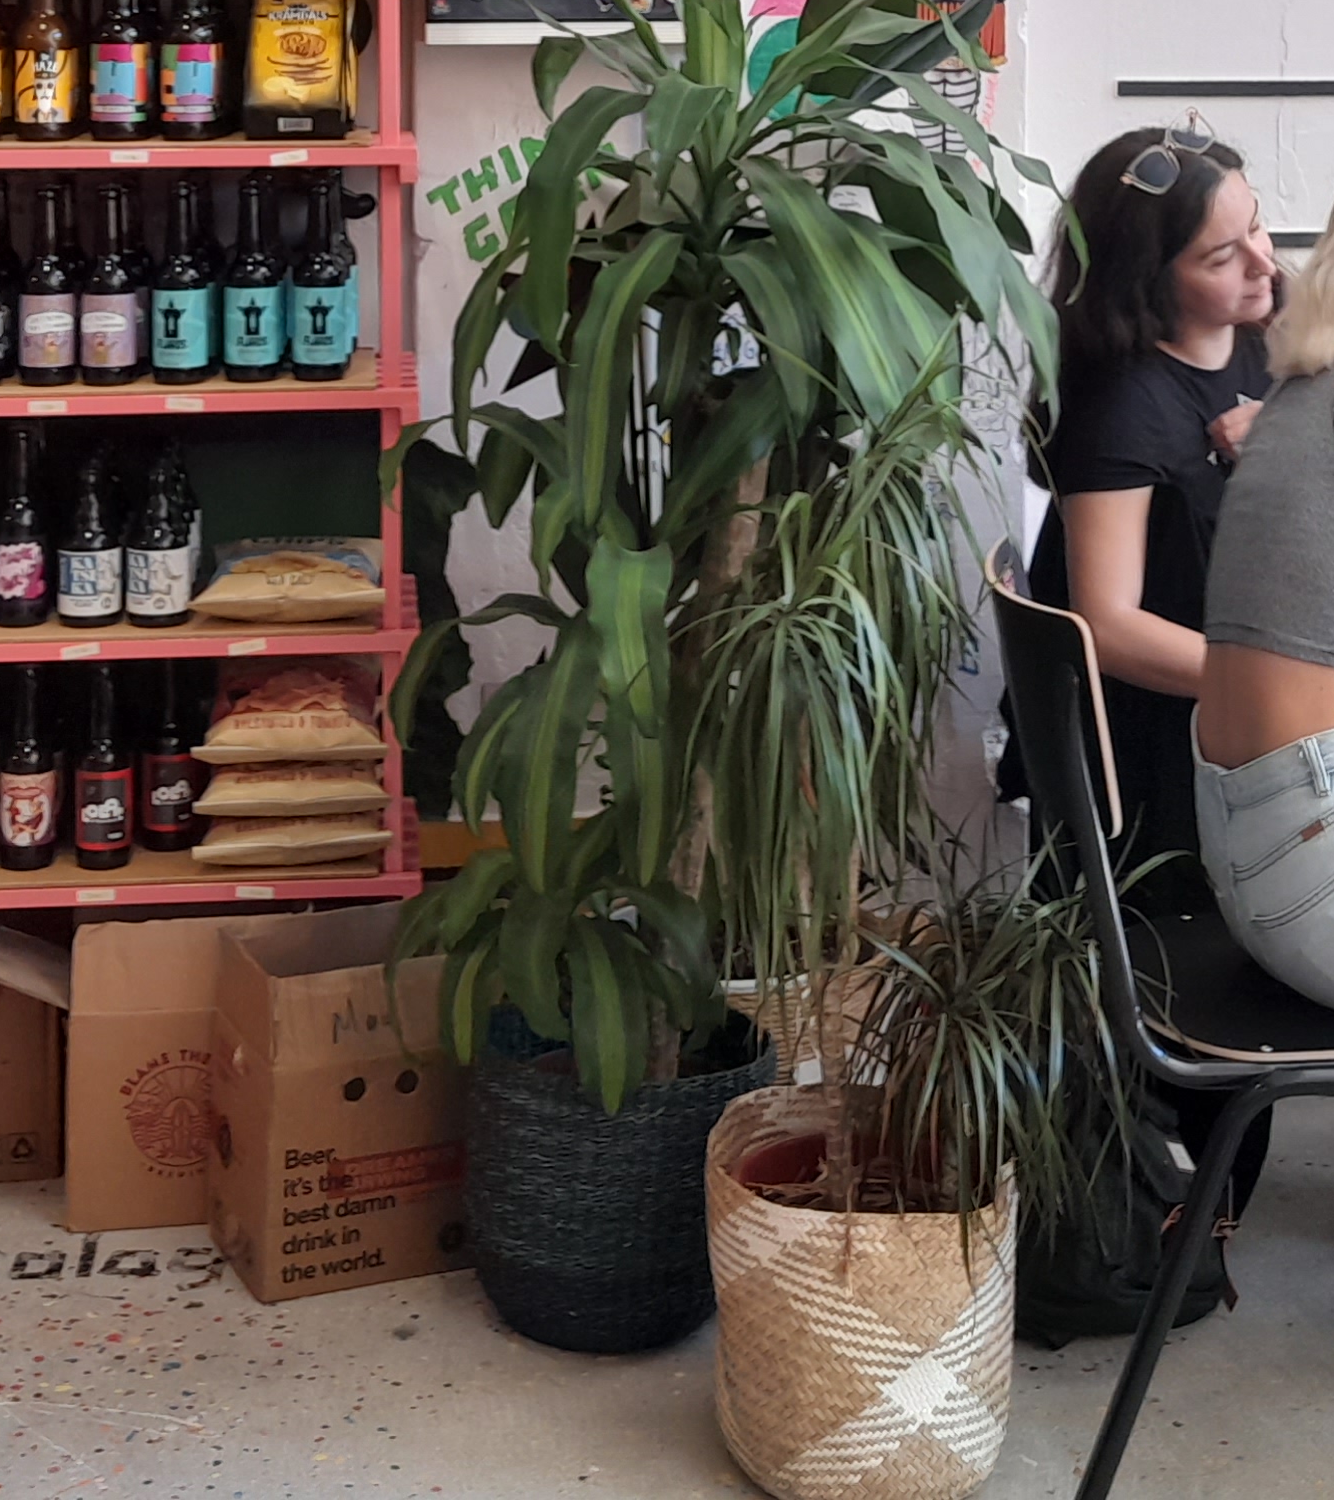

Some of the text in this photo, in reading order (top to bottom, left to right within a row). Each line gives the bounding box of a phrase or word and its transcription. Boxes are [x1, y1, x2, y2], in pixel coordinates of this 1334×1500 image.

[283, 1173, 354, 1198] it's the
[283, 1195, 396, 1227] best damn
[282, 1225, 361, 1255] drink in
[281, 1248, 386, 1284] the world.
